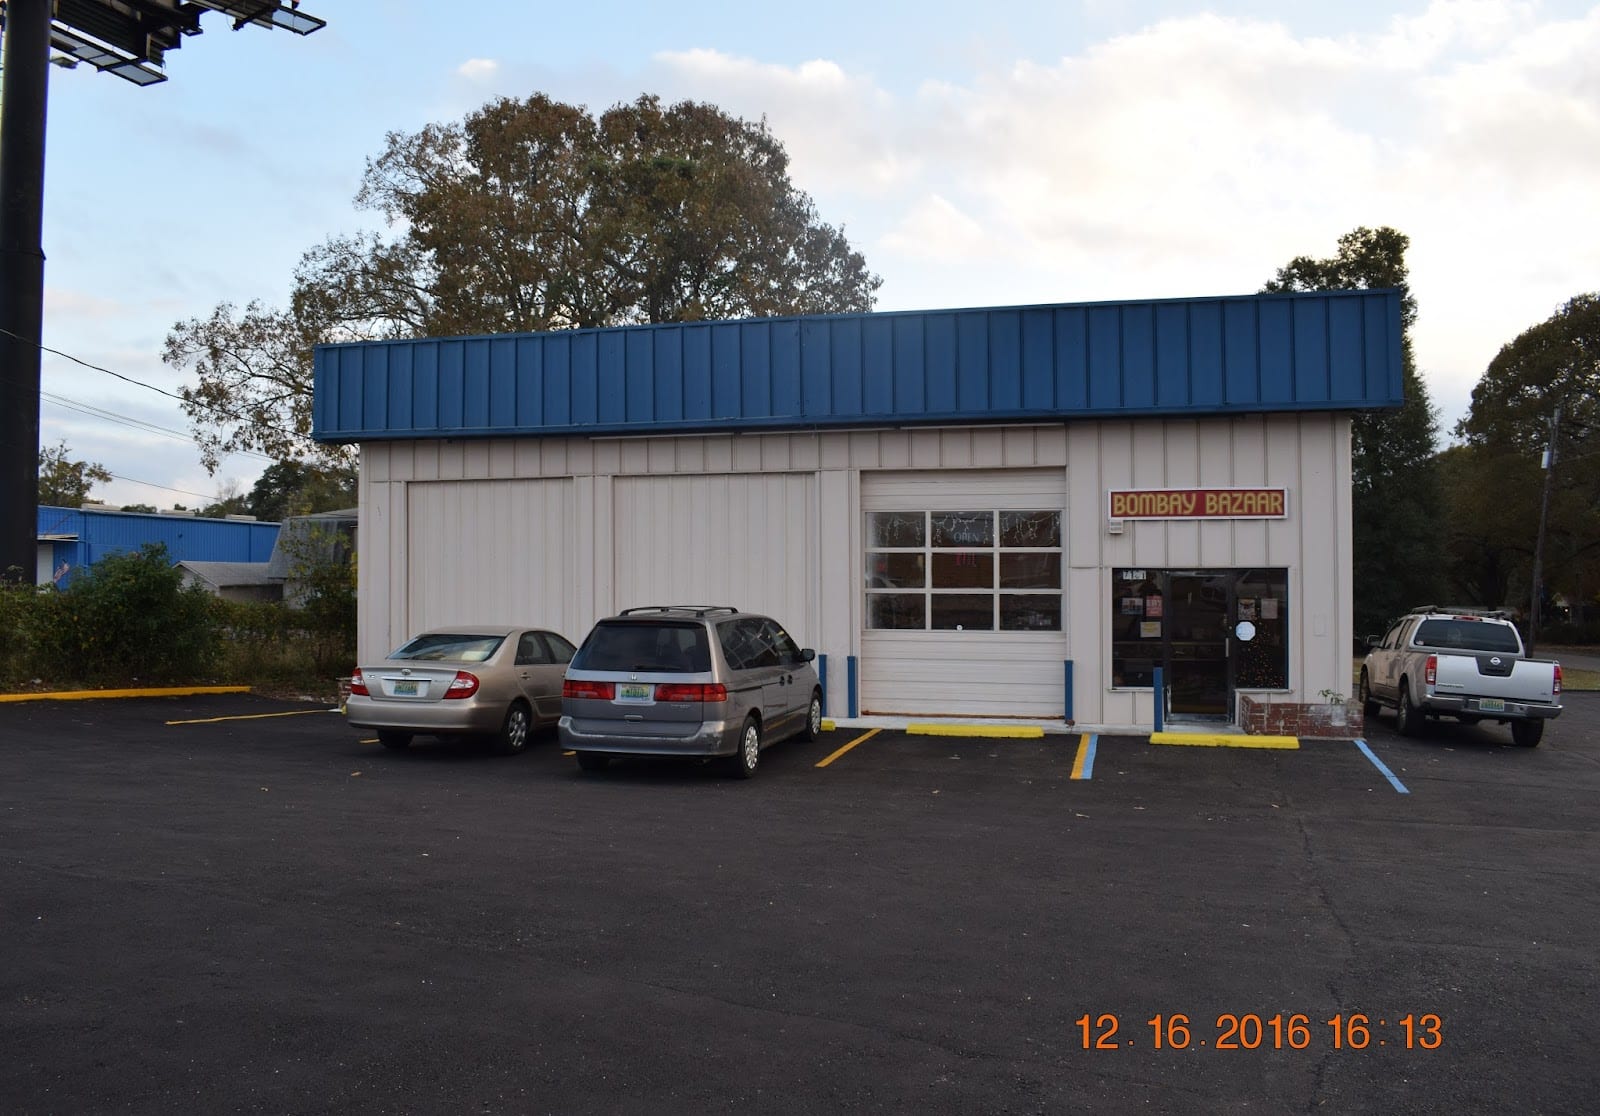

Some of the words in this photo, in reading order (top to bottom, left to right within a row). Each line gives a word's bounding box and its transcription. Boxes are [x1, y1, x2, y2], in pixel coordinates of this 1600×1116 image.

[1113, 493, 1196, 515] BOMBAY
[1205, 491, 1283, 514] BAZAAR
[953, 531, 979, 543] OPEN
